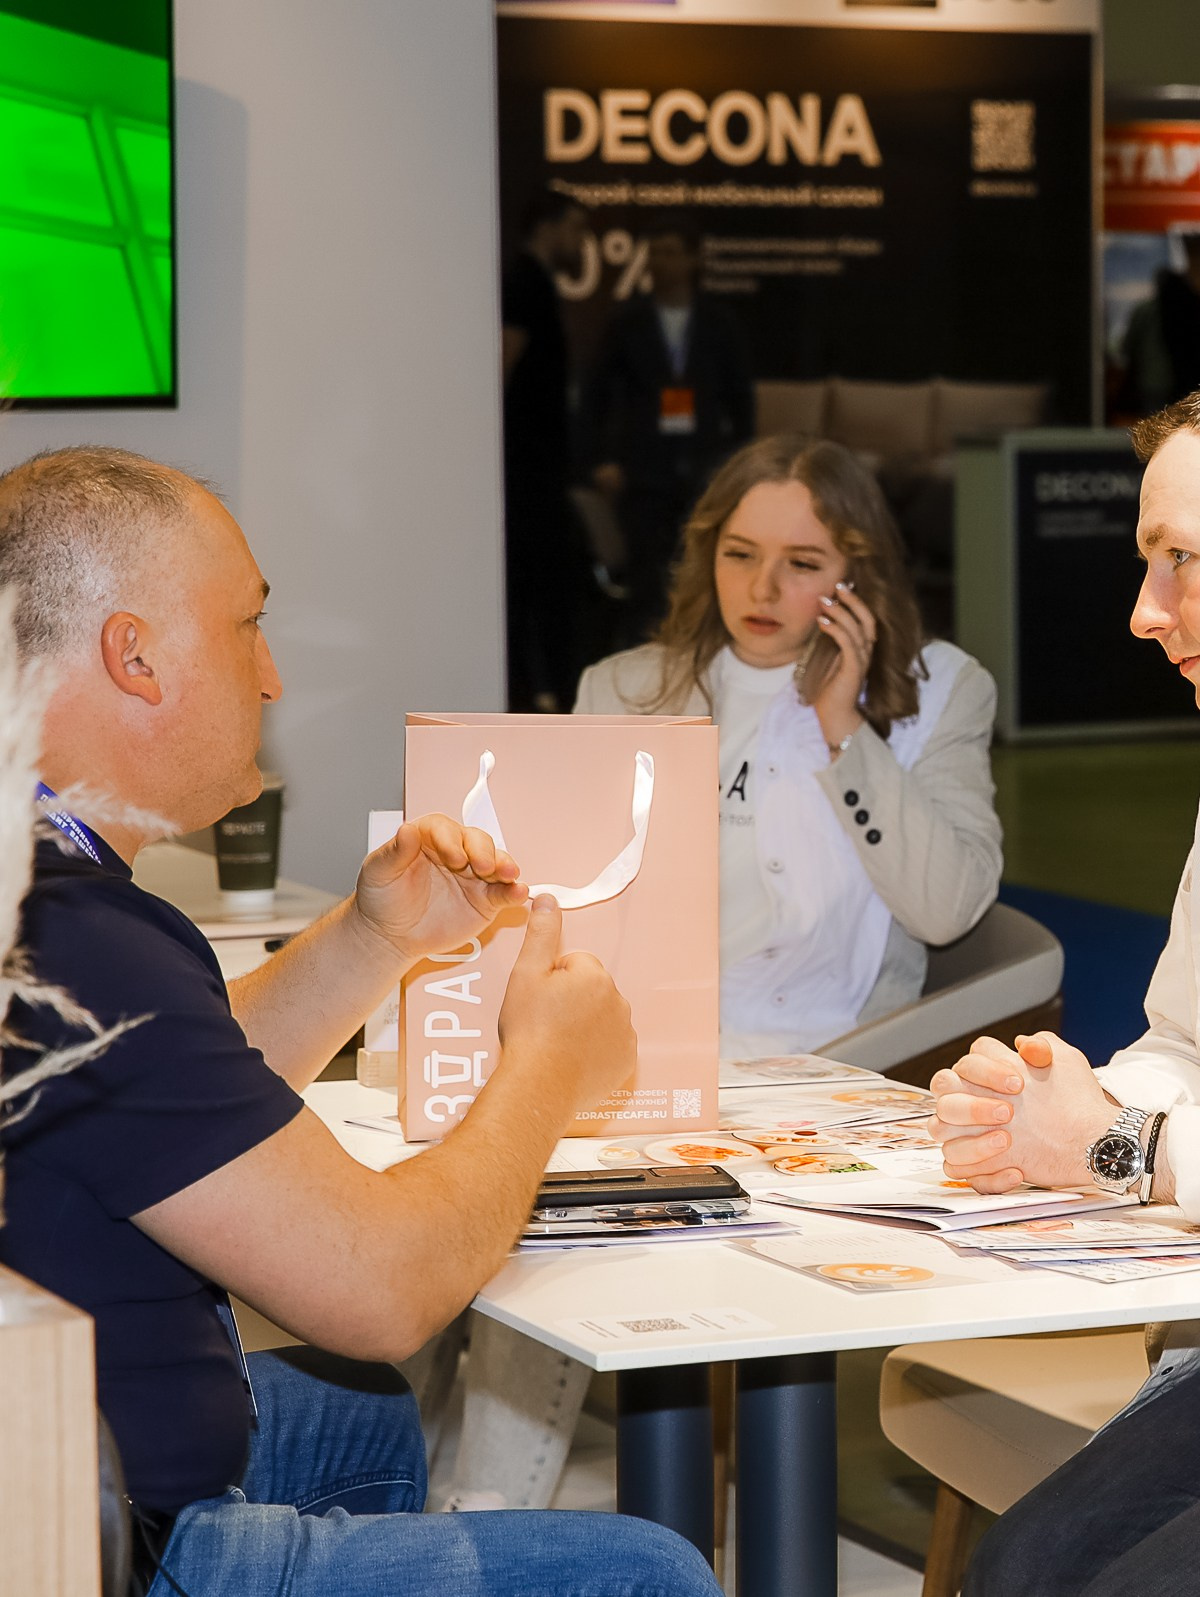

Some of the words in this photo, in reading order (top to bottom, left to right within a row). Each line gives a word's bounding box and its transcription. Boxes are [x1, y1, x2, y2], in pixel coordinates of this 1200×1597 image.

[544, 88, 882, 166] DECONA
[611, 1089, 632, 1098] СЕТЬ
[633, 1089, 668, 1097] КОФЕЕН
[596, 1097, 634, 1107] ОРСКОЙ
[635, 1097, 668, 1106] КУХНЕЙ
[575, 1109, 668, 1121] ZDRASTECAFE.RU
